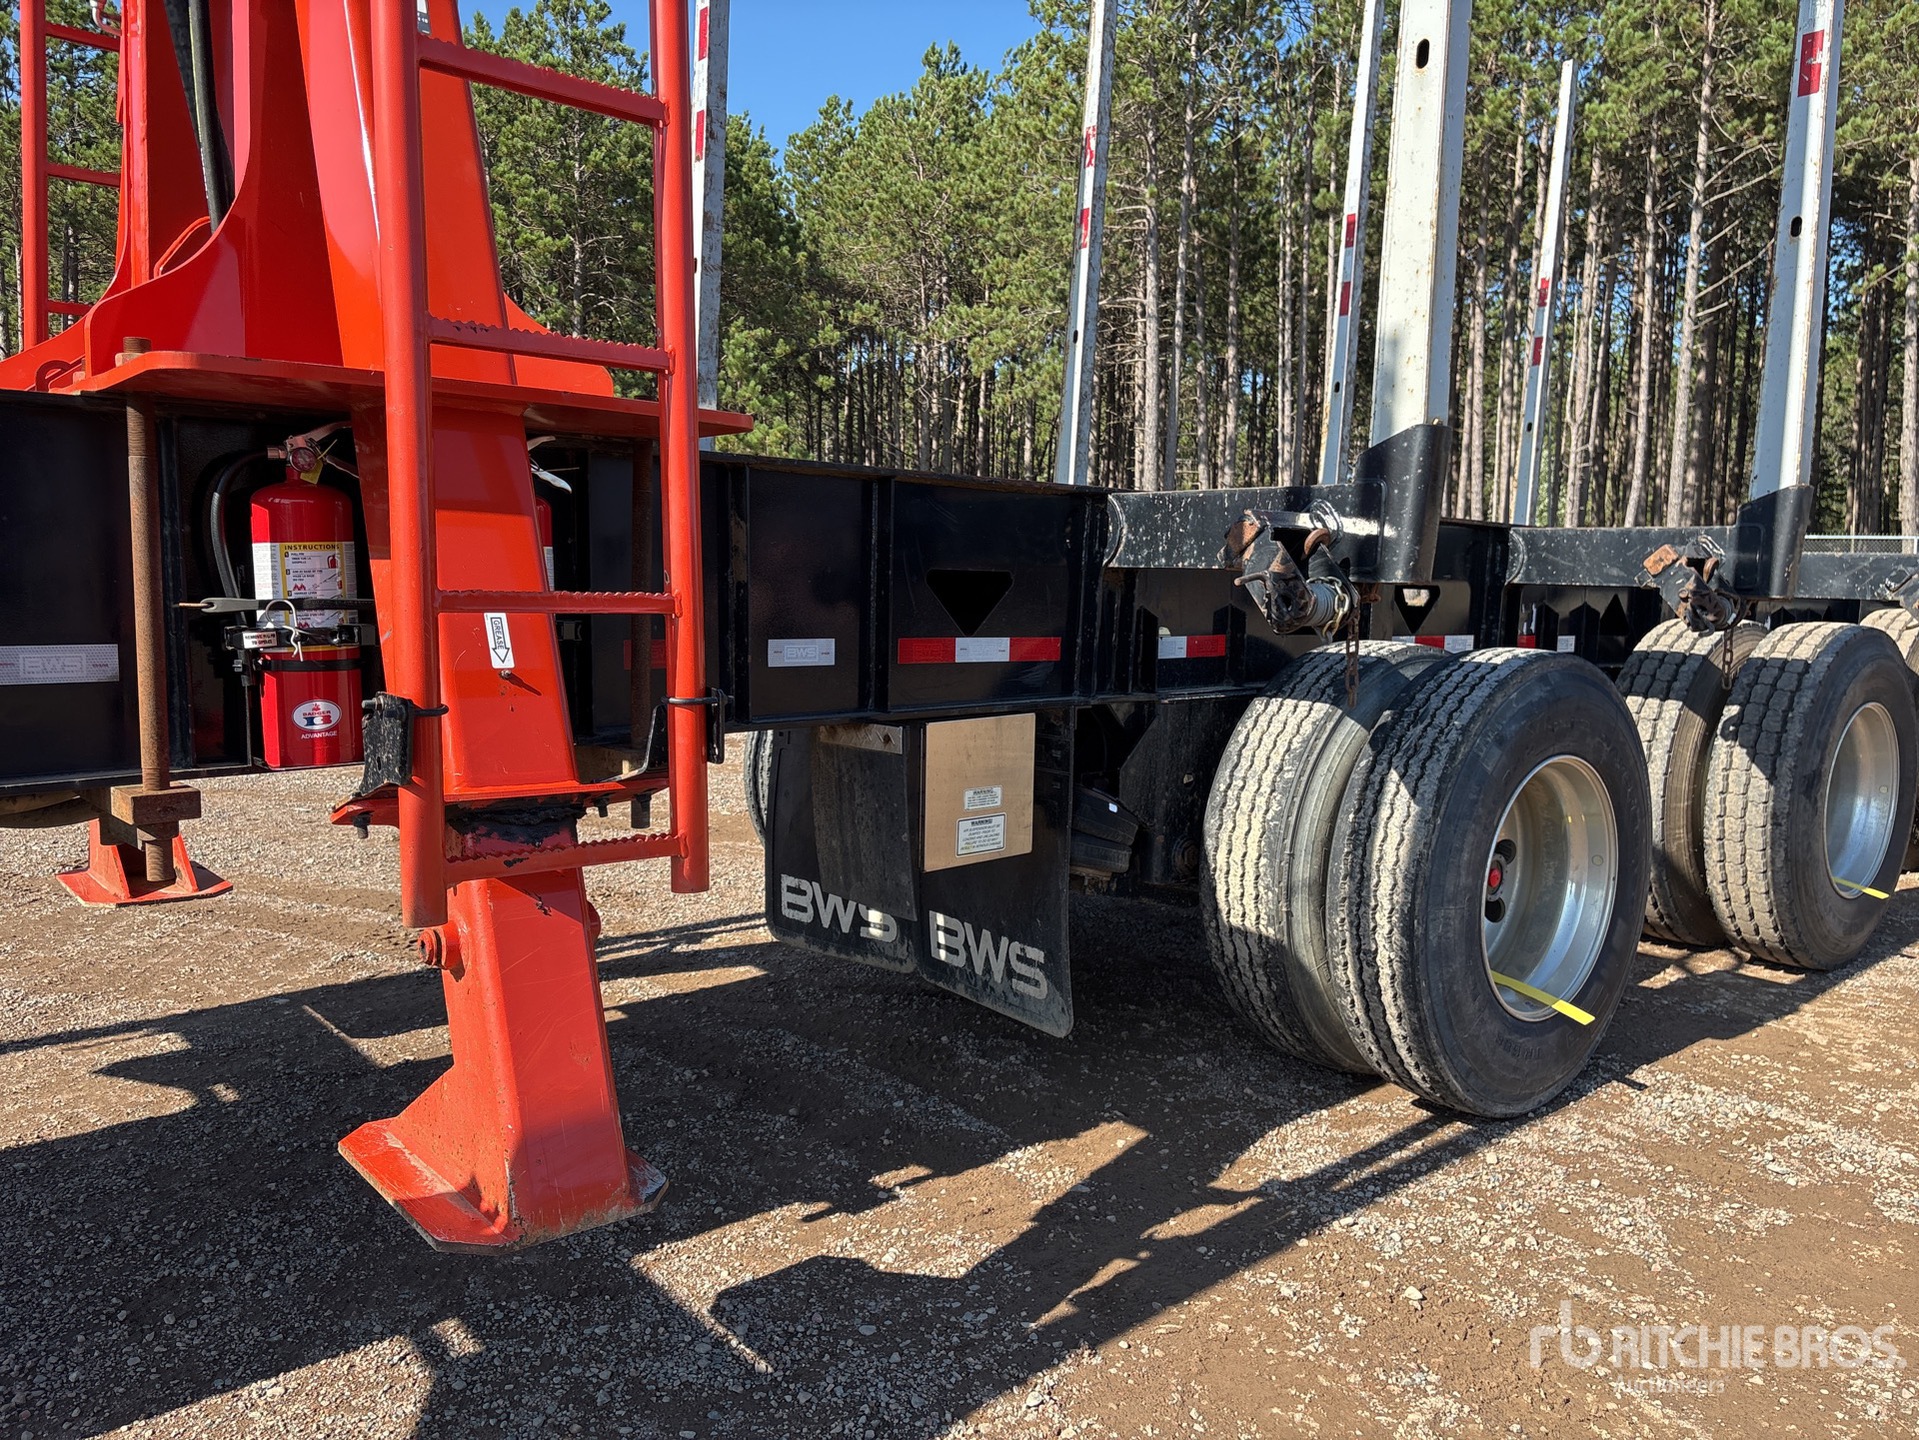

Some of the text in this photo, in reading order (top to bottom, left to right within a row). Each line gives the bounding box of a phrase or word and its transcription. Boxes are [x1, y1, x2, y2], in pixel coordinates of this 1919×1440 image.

[494, 620, 505, 650] GREASE
[787, 648, 816, 658] BWS
[301, 731, 337, 740] ADVANTAGE
[780, 873, 898, 943] BWS
[928, 910, 1048, 1000] BWS
